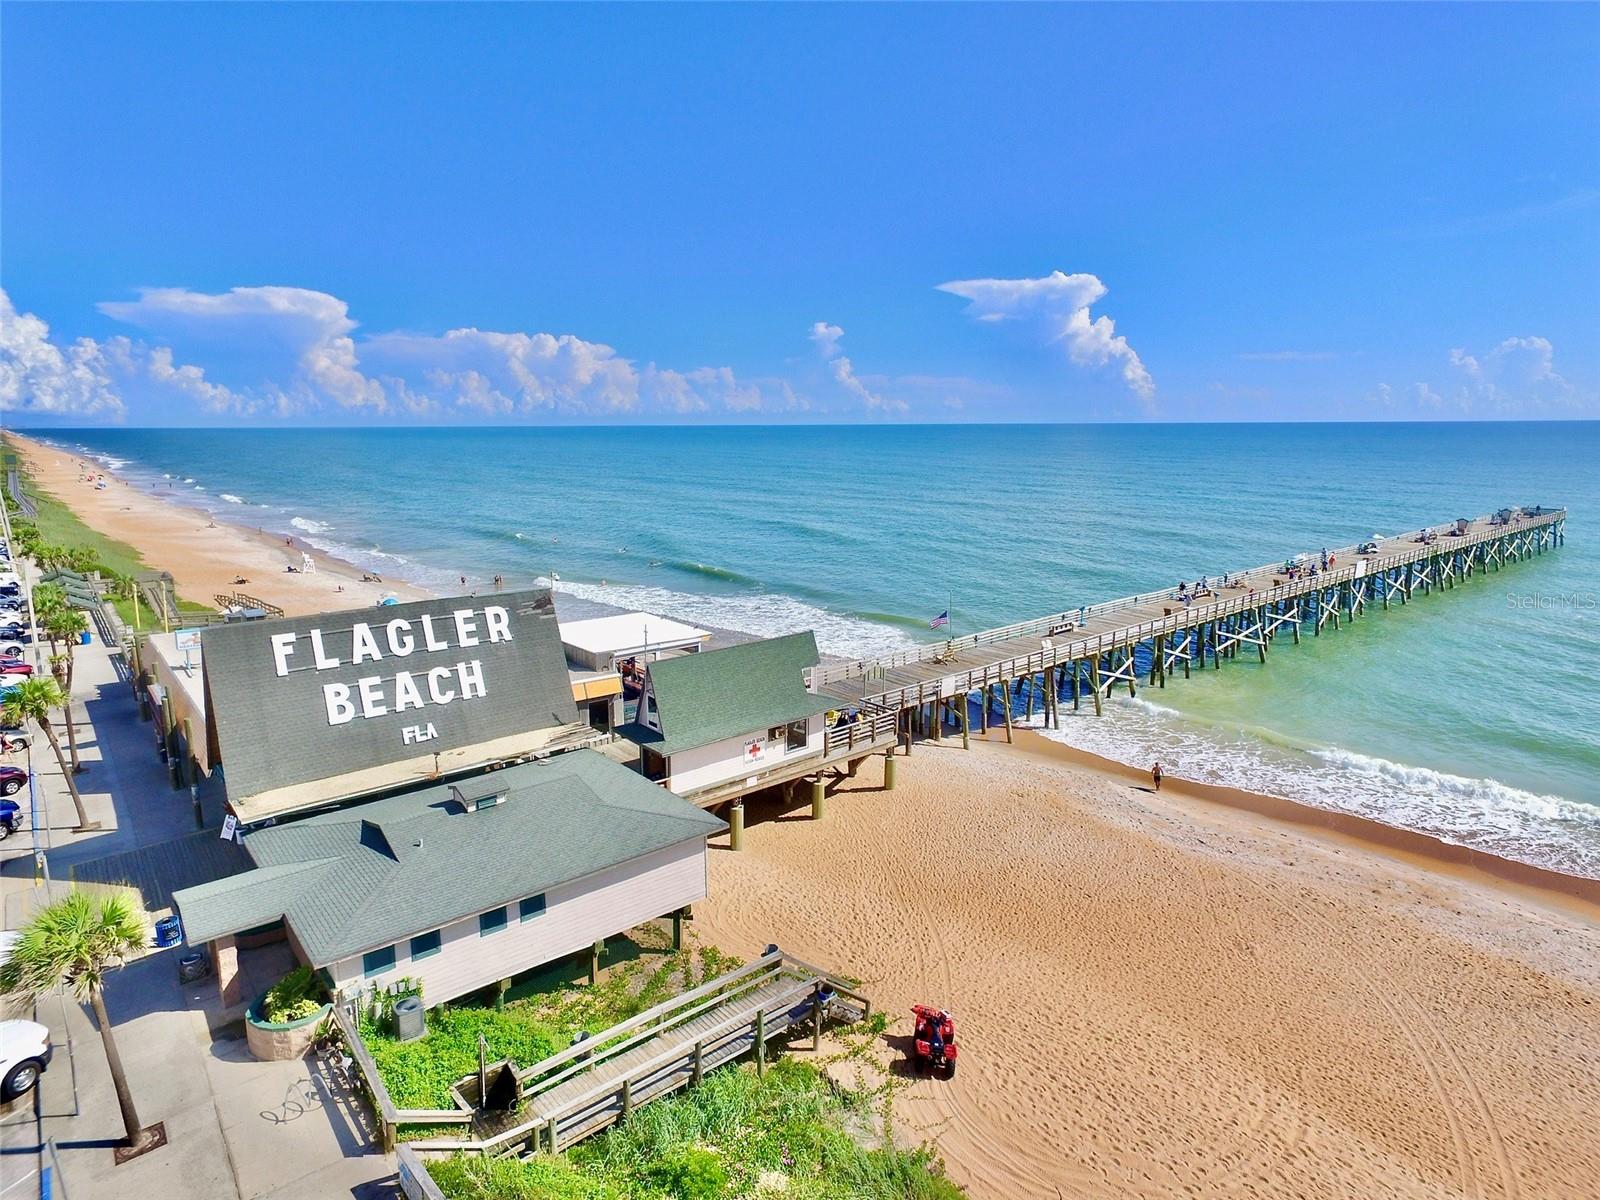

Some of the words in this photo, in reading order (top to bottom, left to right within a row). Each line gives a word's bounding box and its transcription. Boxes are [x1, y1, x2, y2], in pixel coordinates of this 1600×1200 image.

[271, 605, 513, 677] FLAGLER
[323, 660, 487, 725] BEACH
[401, 722, 439, 745] FLA
